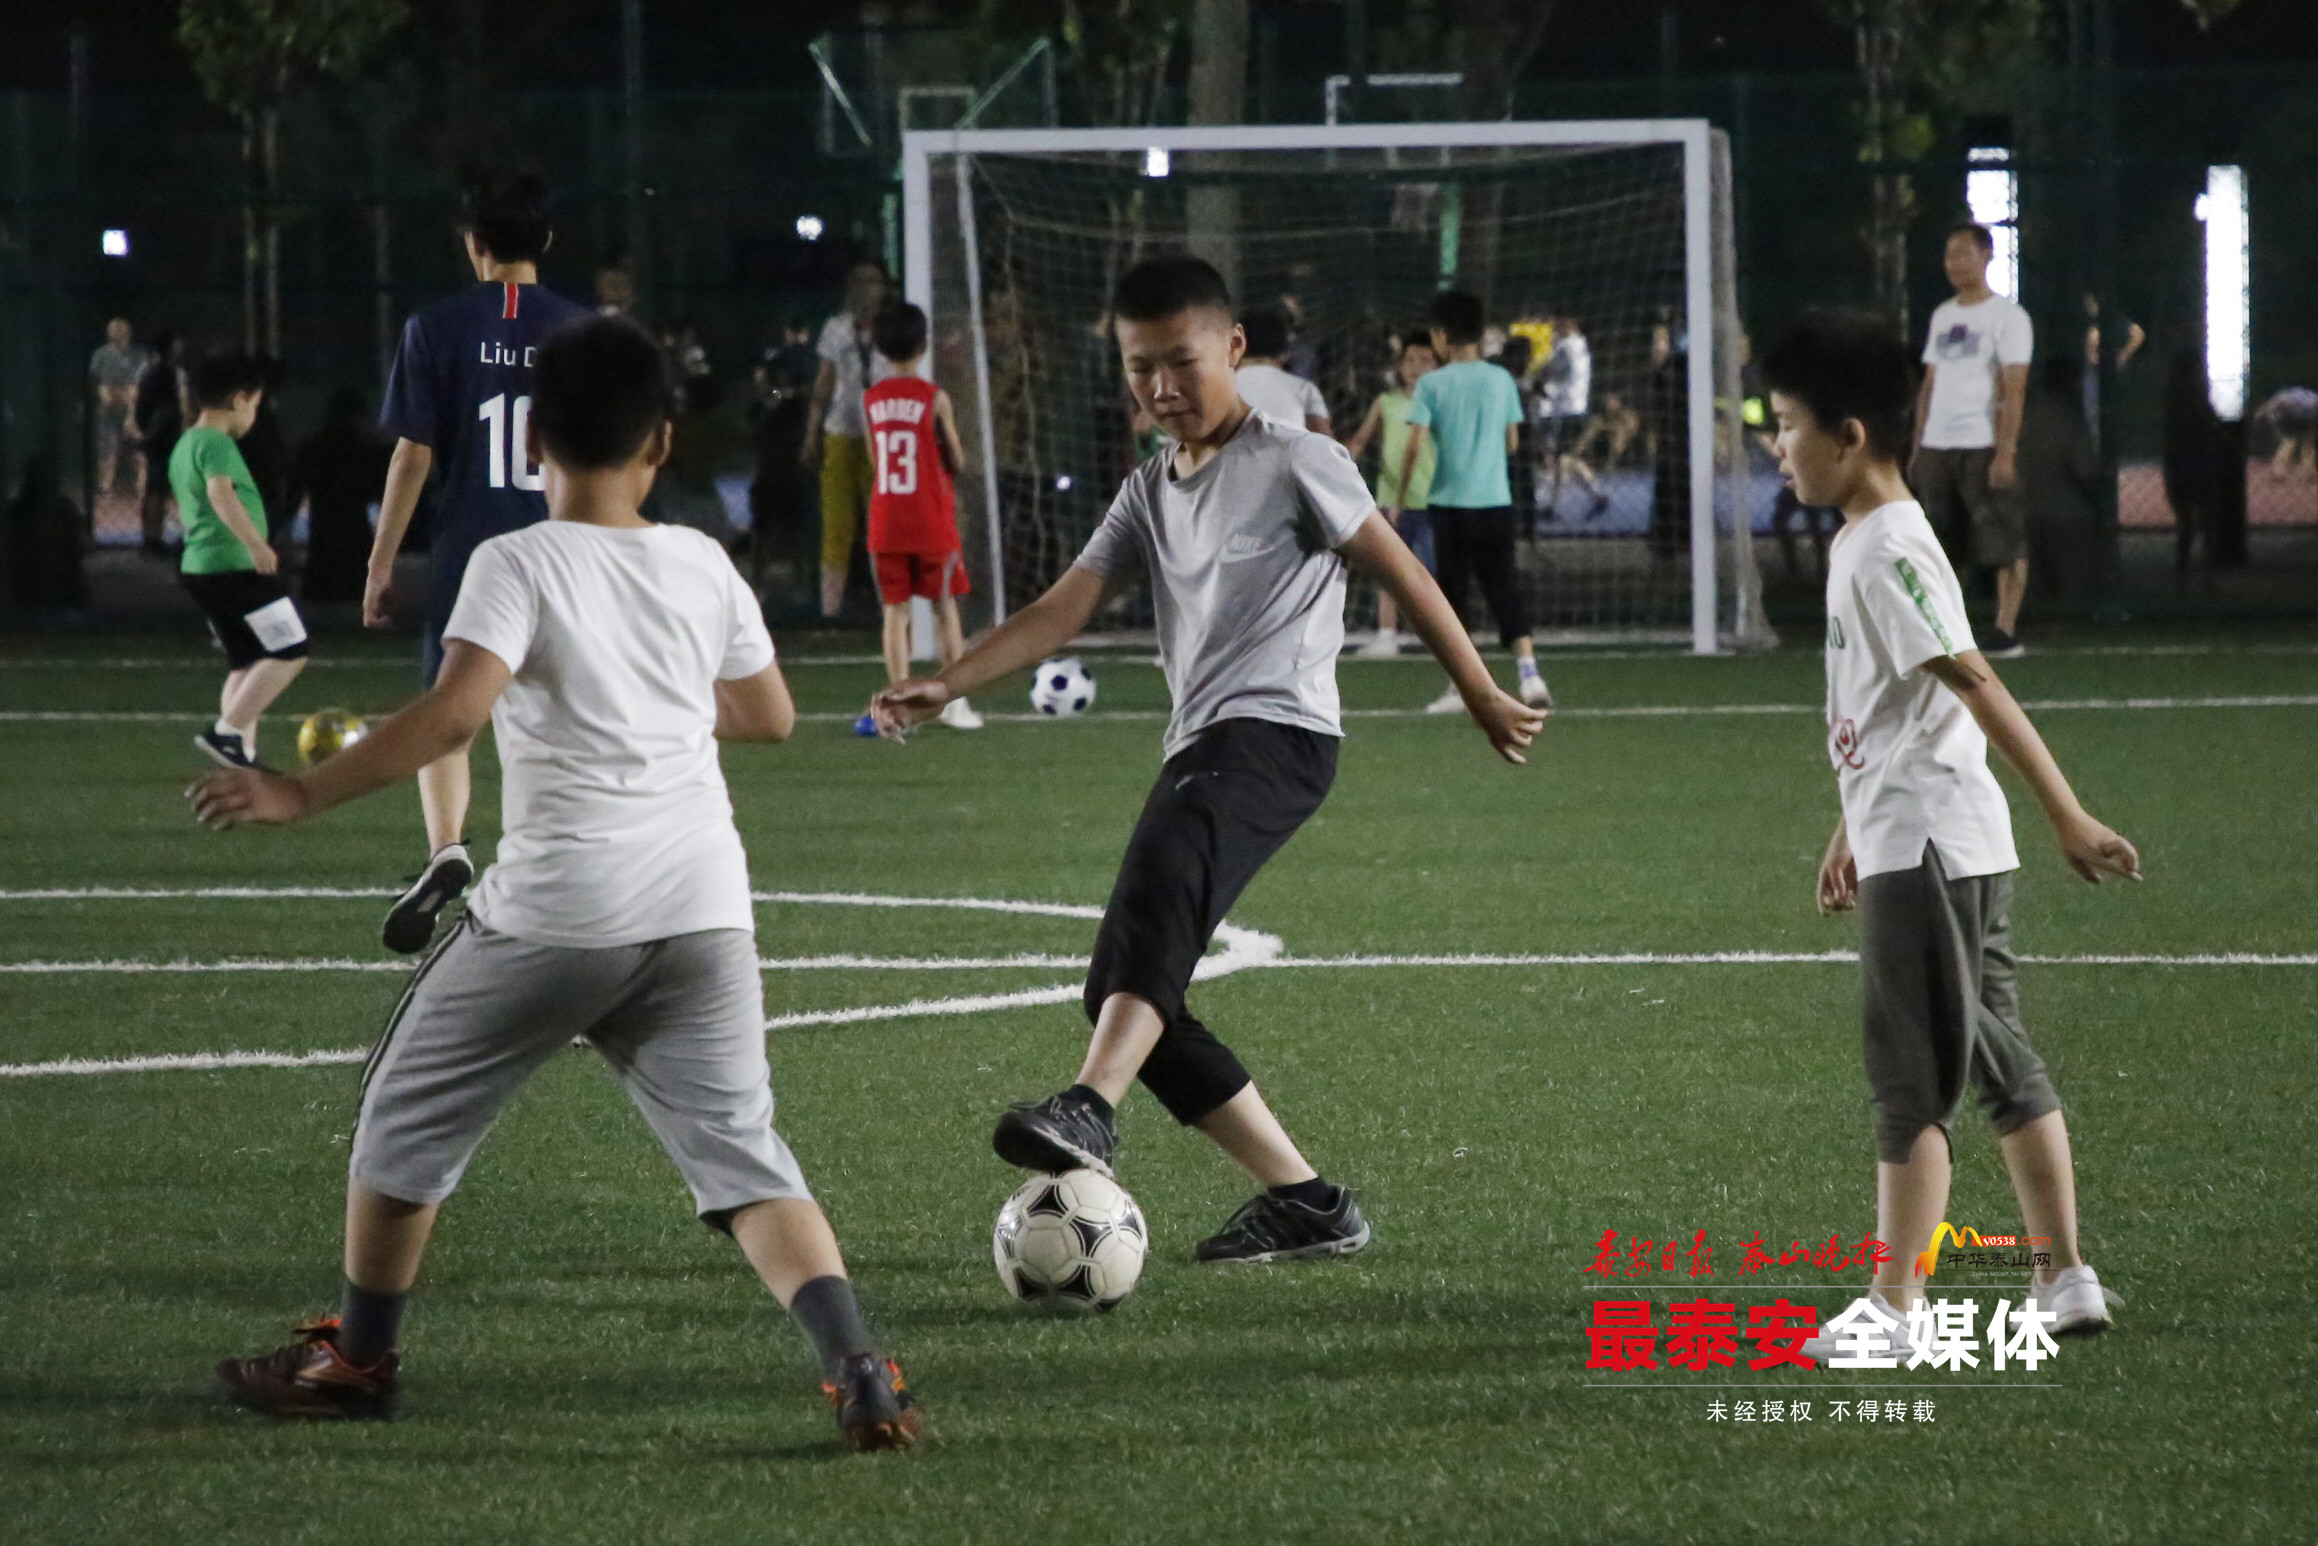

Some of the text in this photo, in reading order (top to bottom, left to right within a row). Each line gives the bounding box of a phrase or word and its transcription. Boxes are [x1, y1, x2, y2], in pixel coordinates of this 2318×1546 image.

[480, 341, 516, 366] Liu
[479, 392, 546, 491] 10
[875, 430, 917, 495] 13
